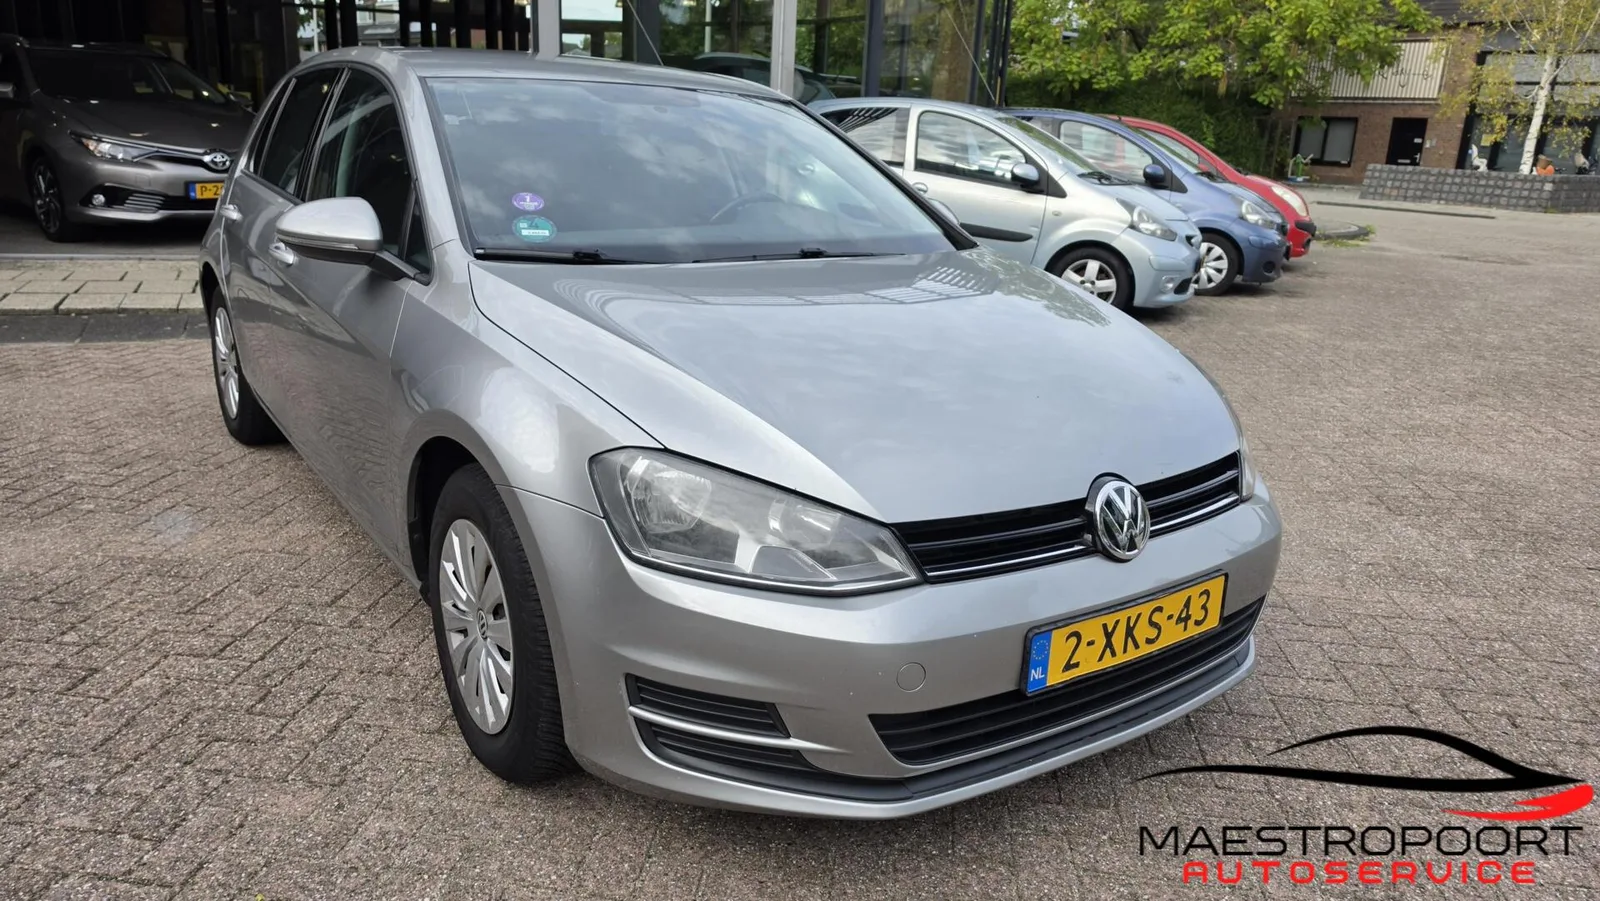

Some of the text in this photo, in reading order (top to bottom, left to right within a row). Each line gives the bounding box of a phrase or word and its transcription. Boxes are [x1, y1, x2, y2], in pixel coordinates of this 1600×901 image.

[200, 185, 225, 197] P-2
[1030, 588, 1211, 681] NL 2-XKS-43
